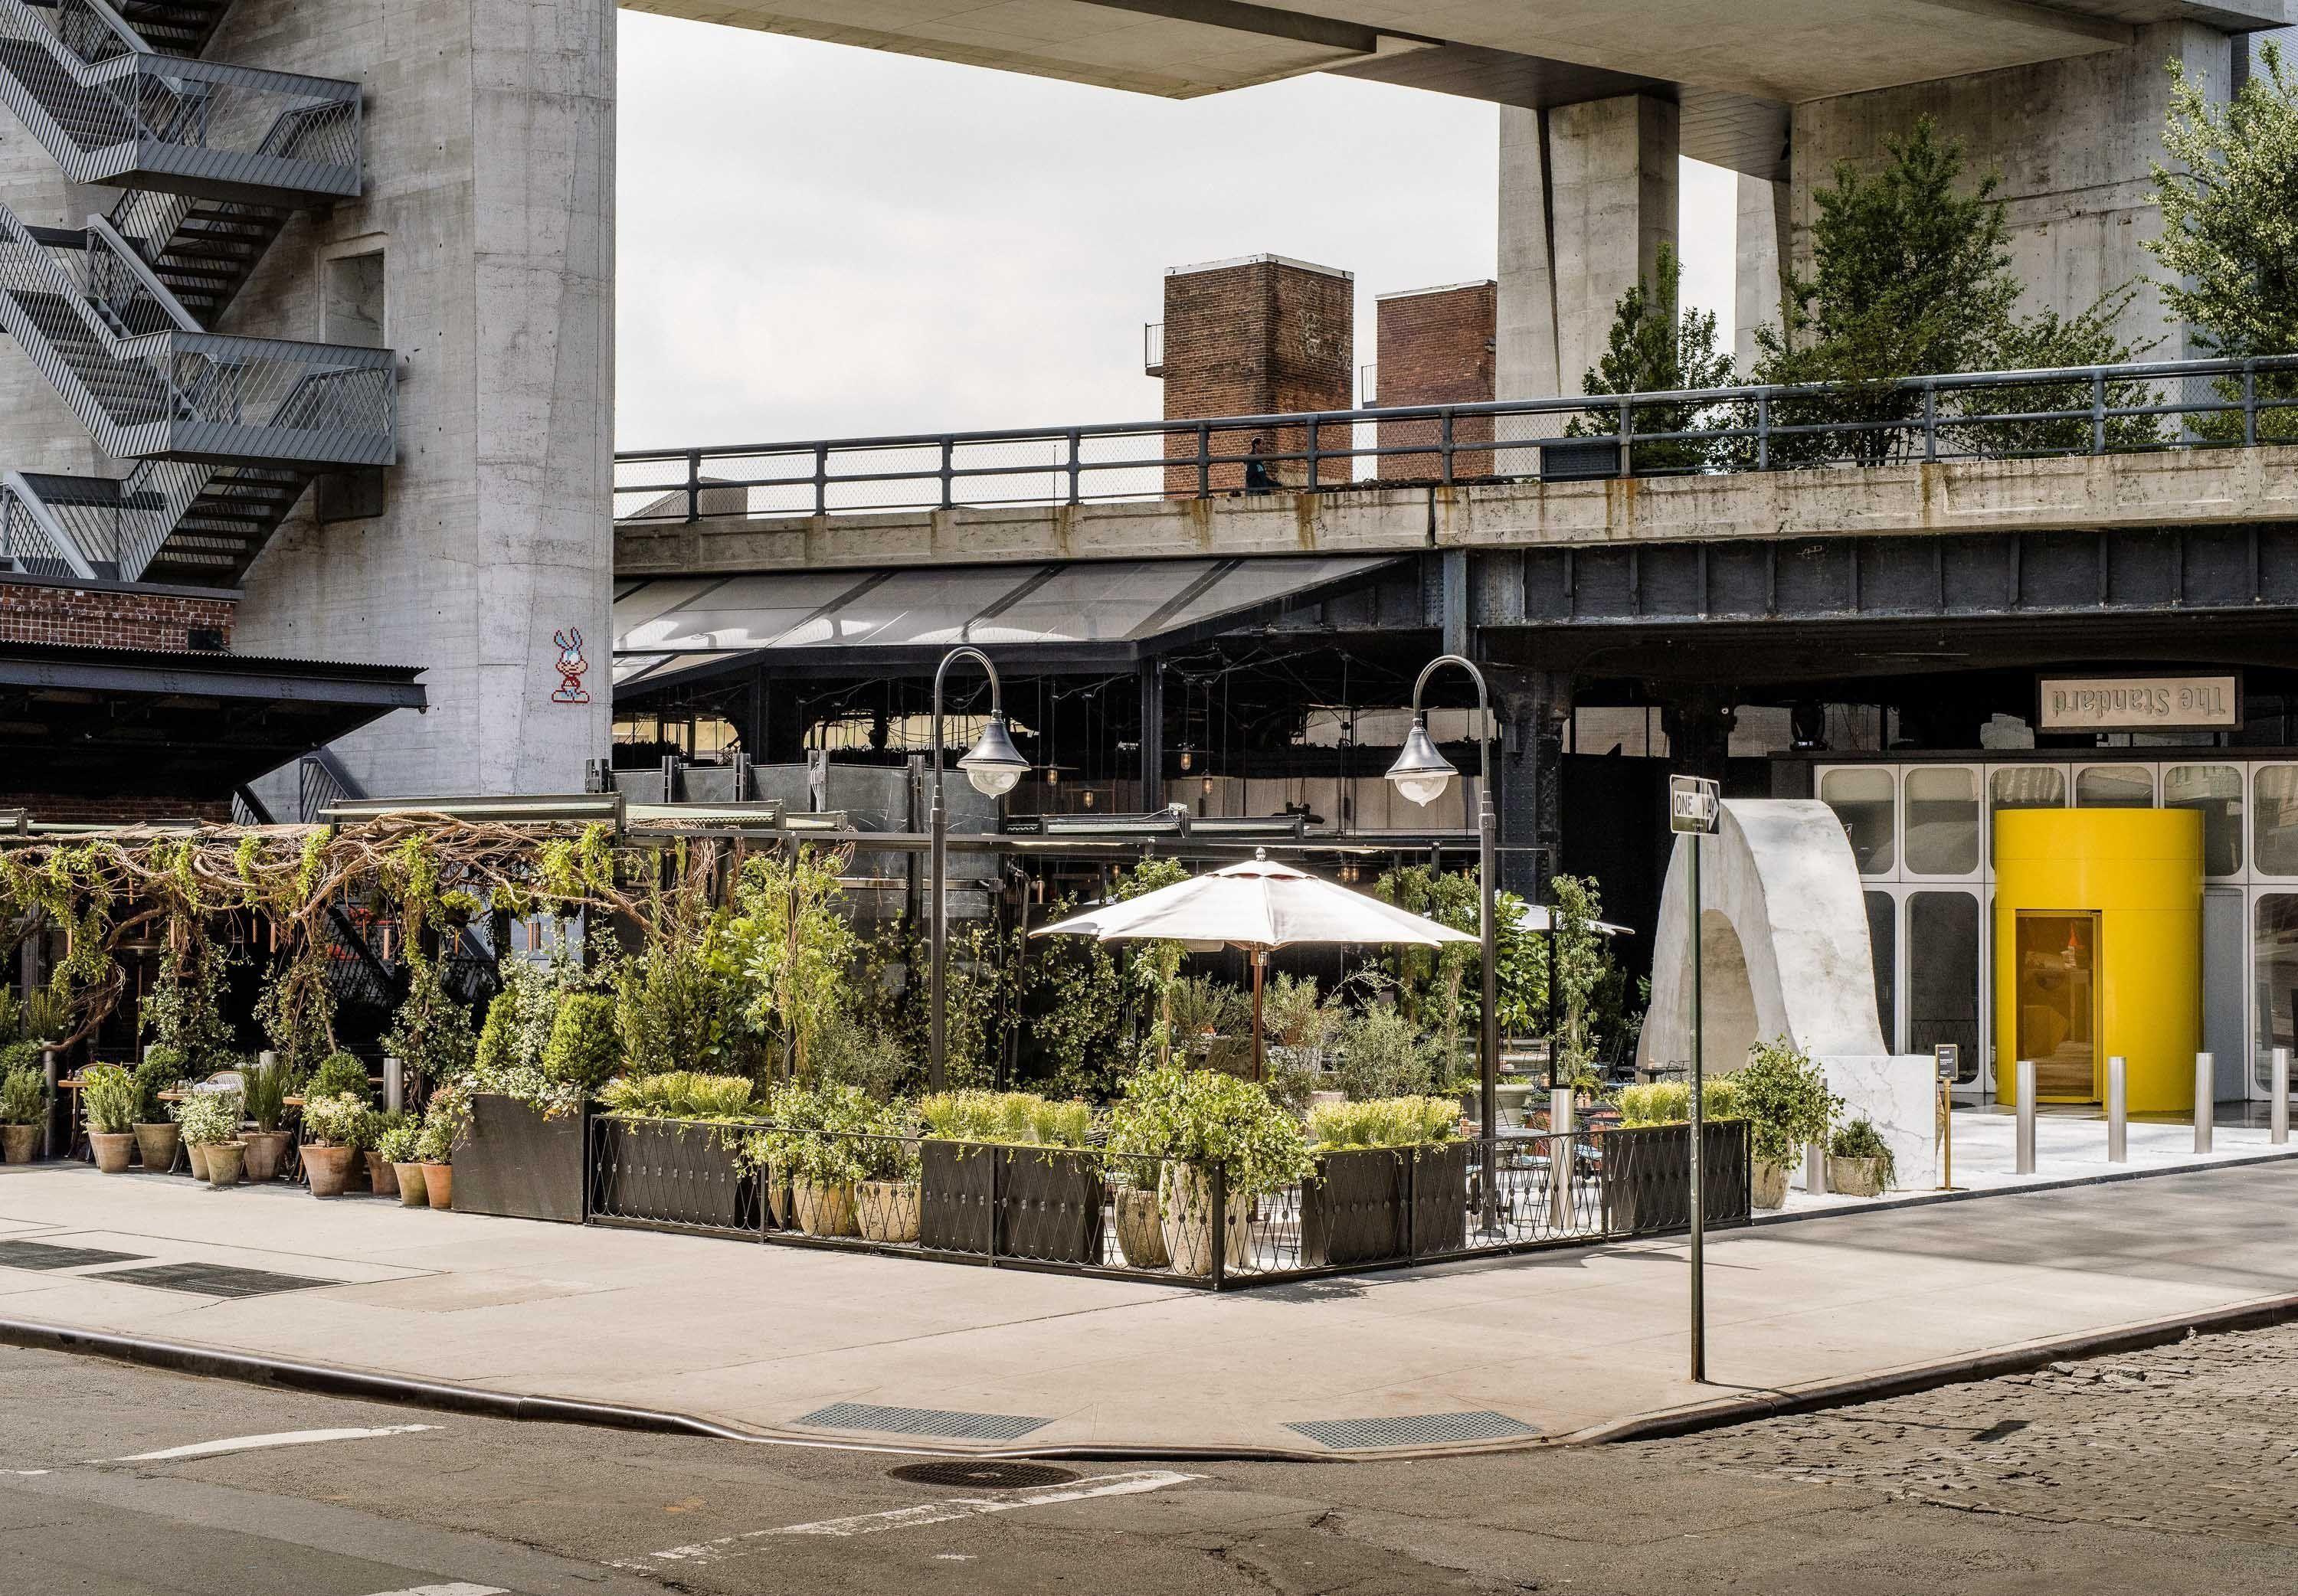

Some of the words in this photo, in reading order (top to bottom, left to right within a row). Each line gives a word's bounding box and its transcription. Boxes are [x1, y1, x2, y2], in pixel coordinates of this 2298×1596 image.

[2052, 687, 2170, 718] Standard
[2179, 687, 2225, 716] The
[1675, 794, 1693, 816] ONE
[1701, 797, 1715, 819] WAY
